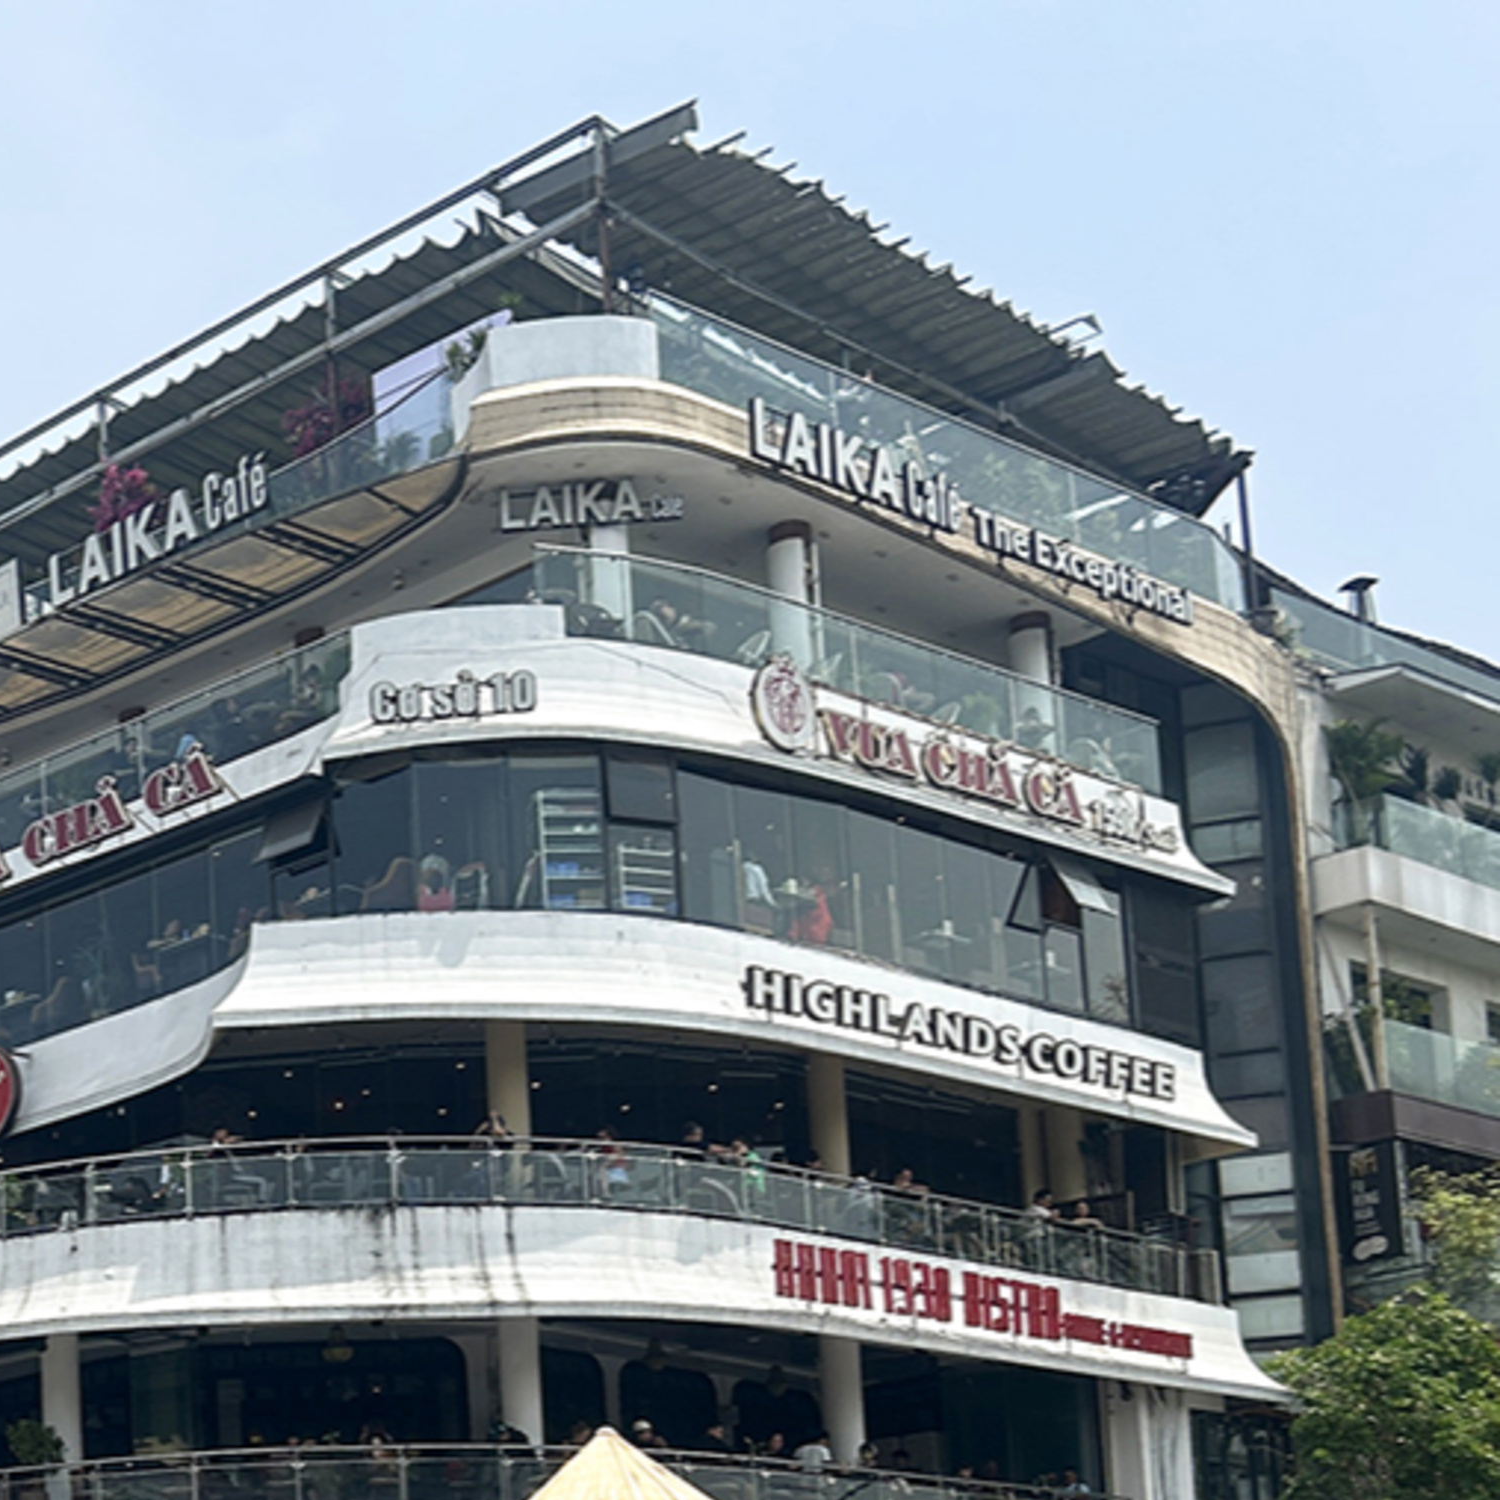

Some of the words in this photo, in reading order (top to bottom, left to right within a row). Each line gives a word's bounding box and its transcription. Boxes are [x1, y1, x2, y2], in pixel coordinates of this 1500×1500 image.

[49, 488, 198, 607] LAIKA
[203, 451, 268, 529] Café
[500, 479, 644, 531] LAIKA
[749, 397, 906, 514] LAIKA
[973, 507, 1031, 560] The
[1031, 530, 1195, 625] Exceptional
[488, 669, 537, 713] 10
[815, 709, 918, 780] VUA
[746, 966, 1022, 1065] HIGHLANDS
[1022, 1032, 1176, 1100] COFFEE
